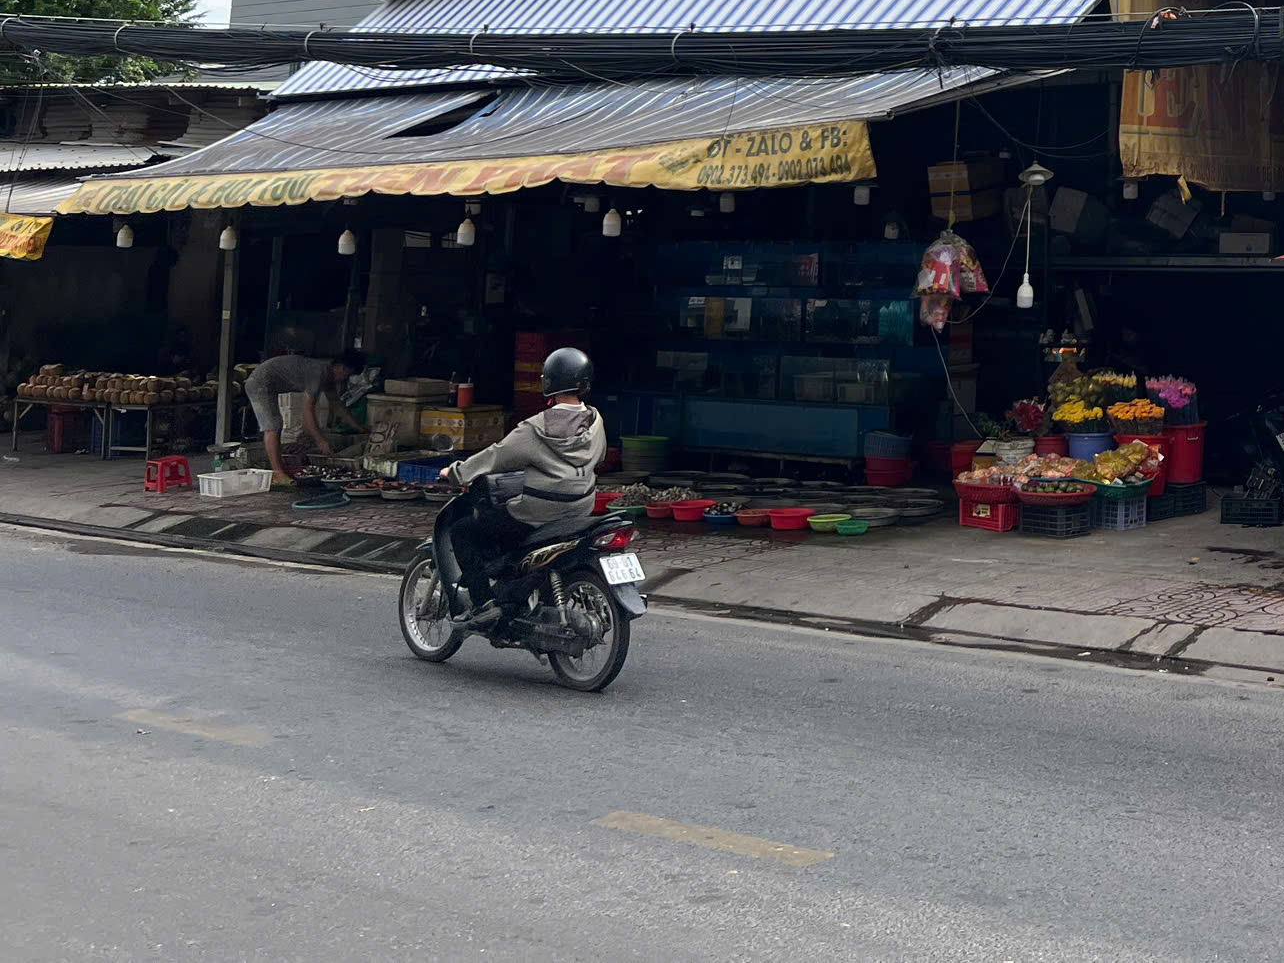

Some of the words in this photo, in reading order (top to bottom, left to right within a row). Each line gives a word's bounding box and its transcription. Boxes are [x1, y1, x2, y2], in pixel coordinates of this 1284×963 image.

[746, 132, 793, 157] ZALO
[800, 130, 813, 152] &
[820, 126, 848, 149] FB:
